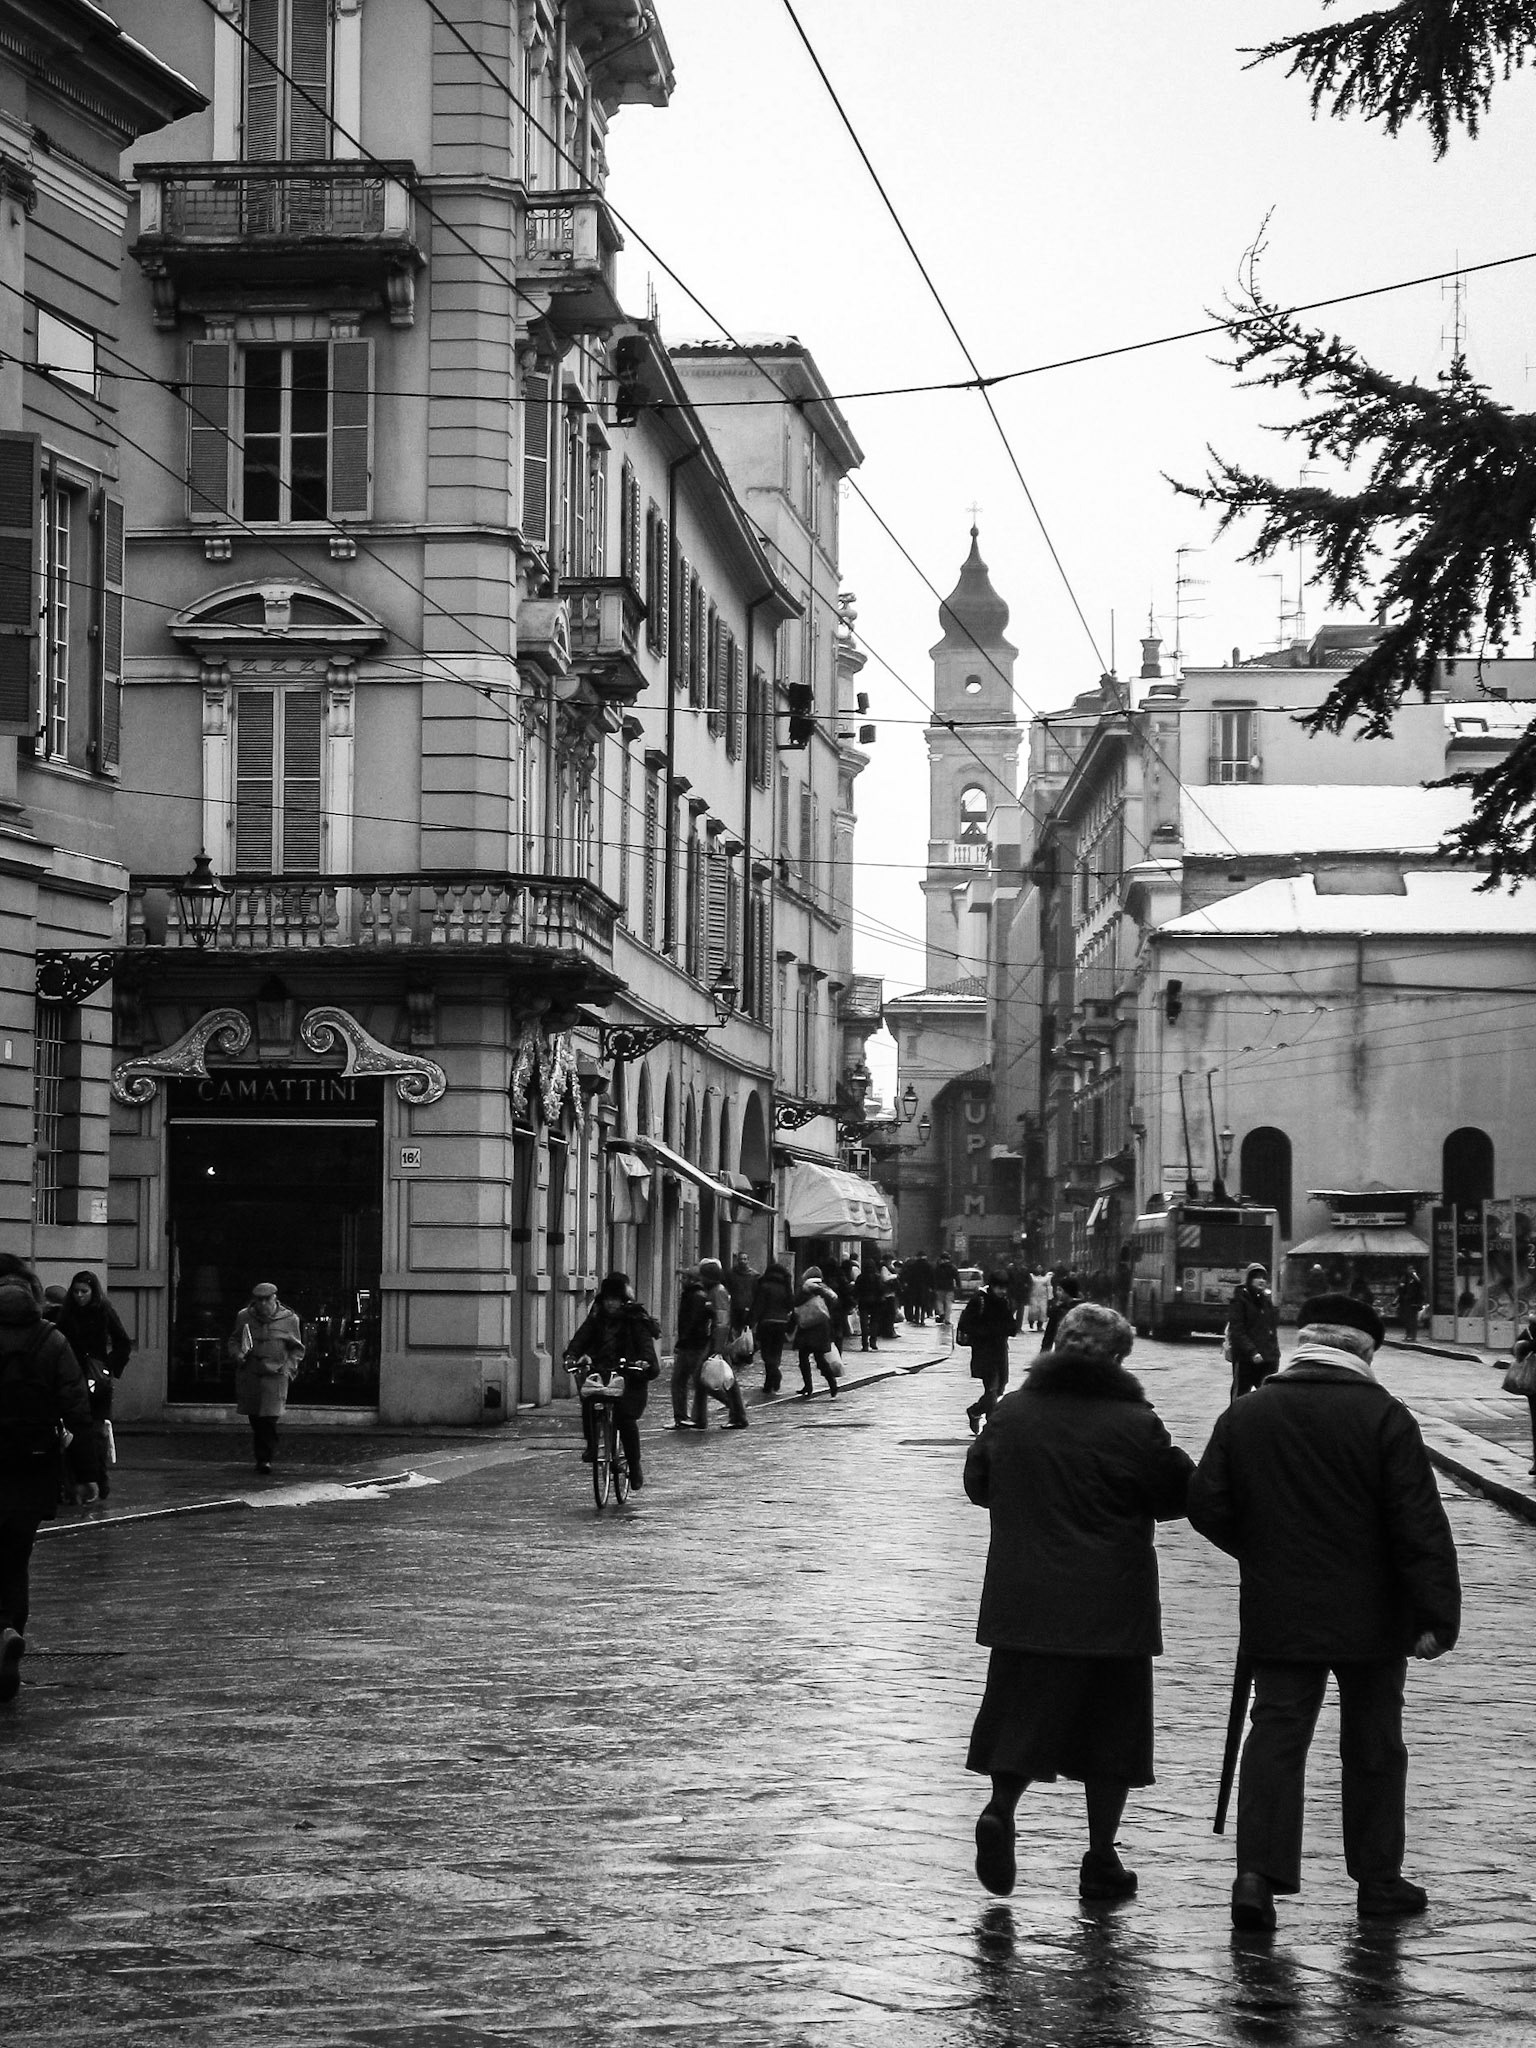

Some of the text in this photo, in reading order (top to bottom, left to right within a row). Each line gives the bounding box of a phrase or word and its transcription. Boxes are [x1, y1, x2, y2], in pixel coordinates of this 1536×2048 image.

[198, 1079, 356, 1101] CAMATTINI
[852, 1150, 867, 1170] T
[964, 1102, 986, 1216] UPIM
